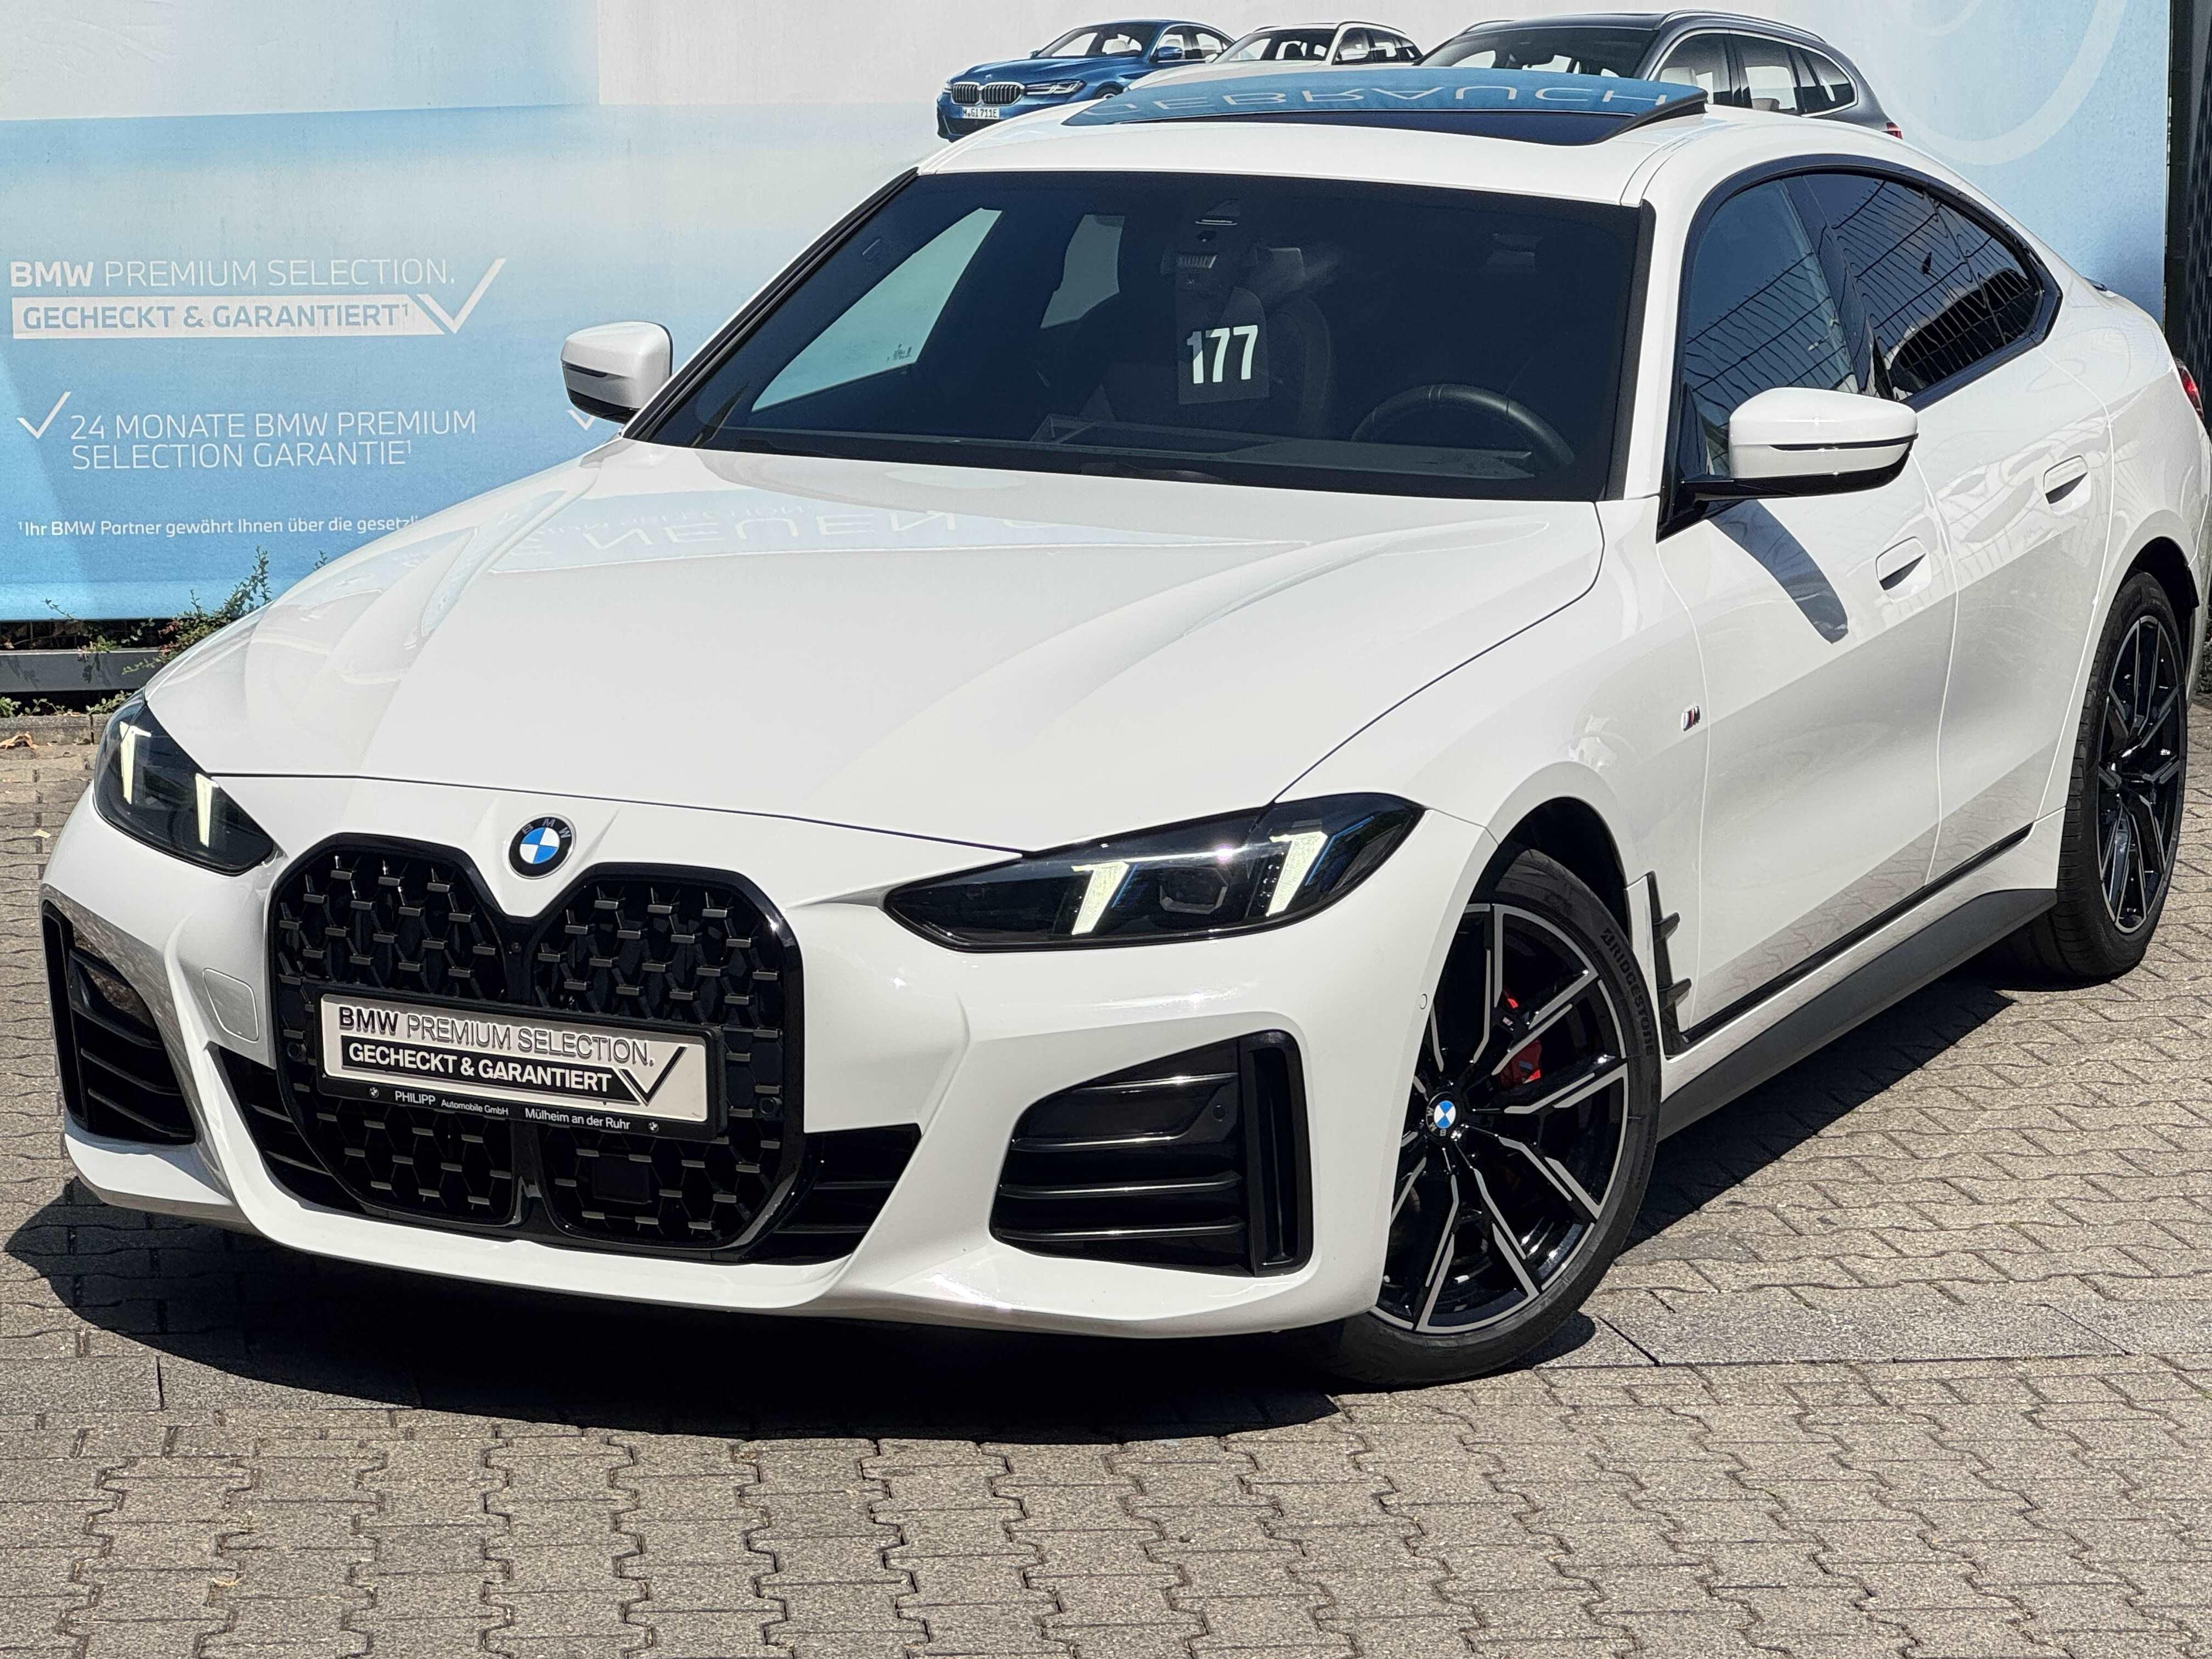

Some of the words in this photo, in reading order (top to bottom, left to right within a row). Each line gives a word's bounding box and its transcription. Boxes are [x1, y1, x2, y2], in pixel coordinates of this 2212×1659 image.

[10, 261, 94, 287] BMW
[105, 259, 256, 286] PREMIUM
[268, 258, 455, 286] SELECTION.
[22, 306, 176, 329] GECHECKT
[183, 305, 205, 328] &
[1187, 325, 1259, 384] 177
[70, 414, 105, 439] 24
[116, 413, 246, 439] MONATE
[255, 413, 328, 438] BMW
[337, 410, 476, 437] PREMIUM
[72, 443, 242, 470] SELECTION
[52, 521, 96, 536] BMW
[101, 520, 162, 535] Partner
[166, 519, 233, 538] gewährt
[238, 518, 284, 533] Ihnen
[288, 517, 325, 533] über
[329, 516, 353, 532] die
[522, 818, 572, 839] BMW
[1600, 927, 1655, 1056] BRIDGESTONE
[339, 1006, 399, 1036] BMW
[407, 1014, 511, 1051] PREMIUM
[517, 1028, 654, 1067] SELECTION.
[348, 1042, 458, 1074] GECHECKT
[460, 1057, 475, 1076] &
[478, 1059, 613, 1093] GARANTIERT
[394, 1090, 436, 1105] PHILIPP
[441, 1098, 483, 1112] Automobile
[484, 1104, 509, 1116] GmbH
[524, 1107, 569, 1123] Mülheim
[571, 1115, 585, 1125] an
[586, 1115, 604, 1127] der
[605, 1117, 631, 1130] Ruhr
[1426, 1105, 1447, 1137] BMW
